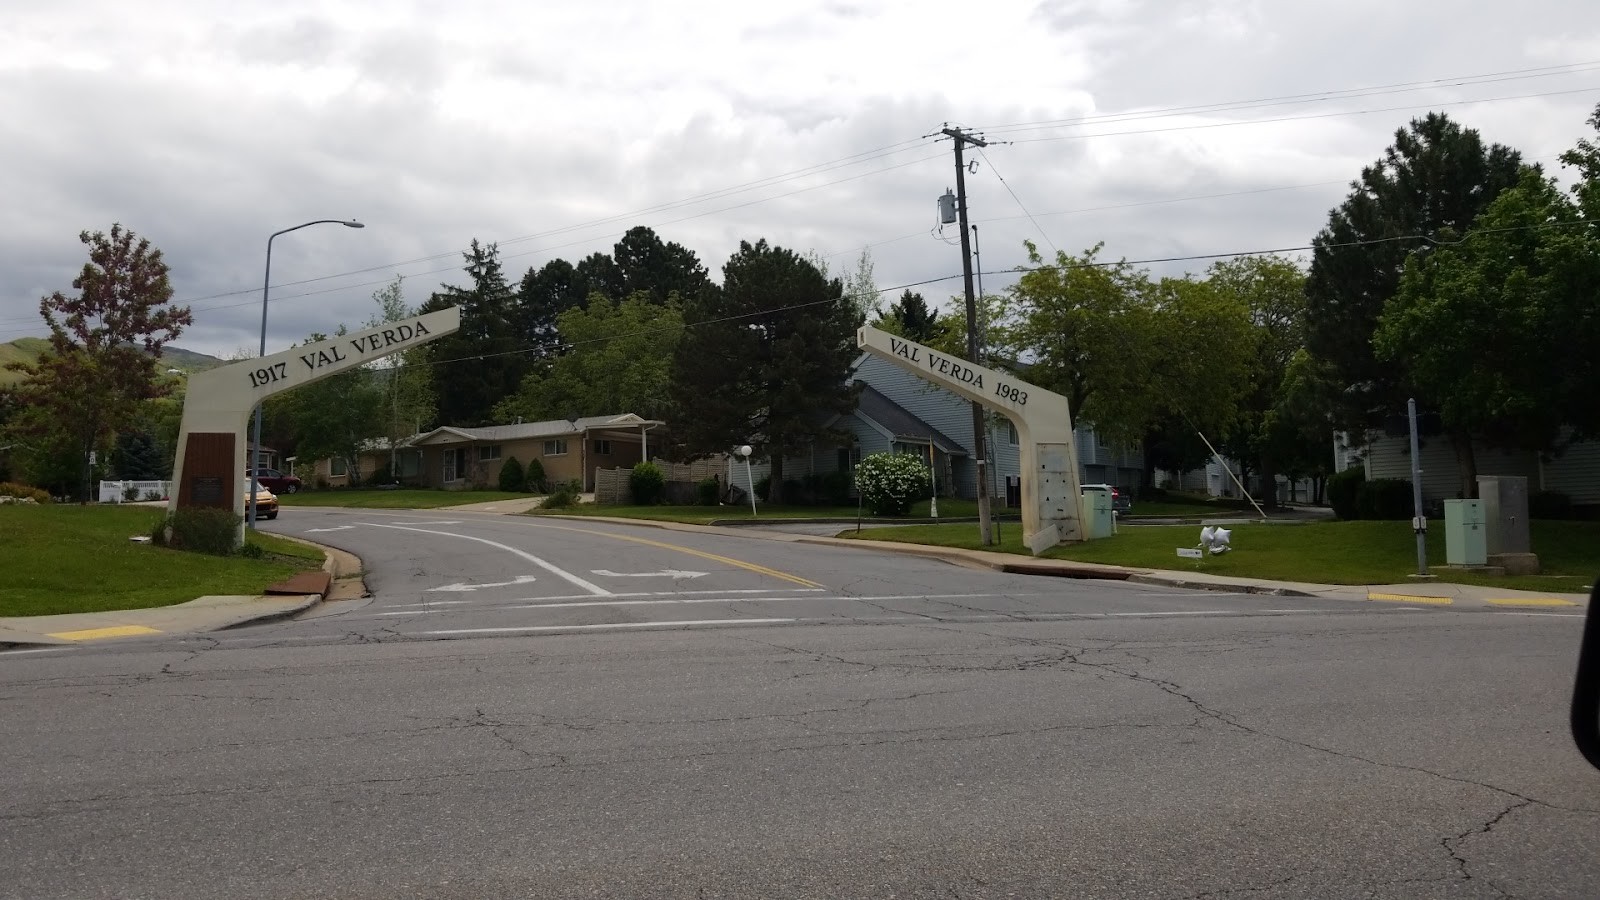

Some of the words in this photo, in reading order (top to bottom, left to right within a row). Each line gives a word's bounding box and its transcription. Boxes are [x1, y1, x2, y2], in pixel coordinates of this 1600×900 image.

[248, 362, 288, 388] 1917
[299, 346, 347, 370] VAL
[350, 321, 431, 354] VERDA
[890, 337, 921, 363] VAL
[928, 353, 984, 389] VERDA
[995, 382, 1029, 406] 1983
